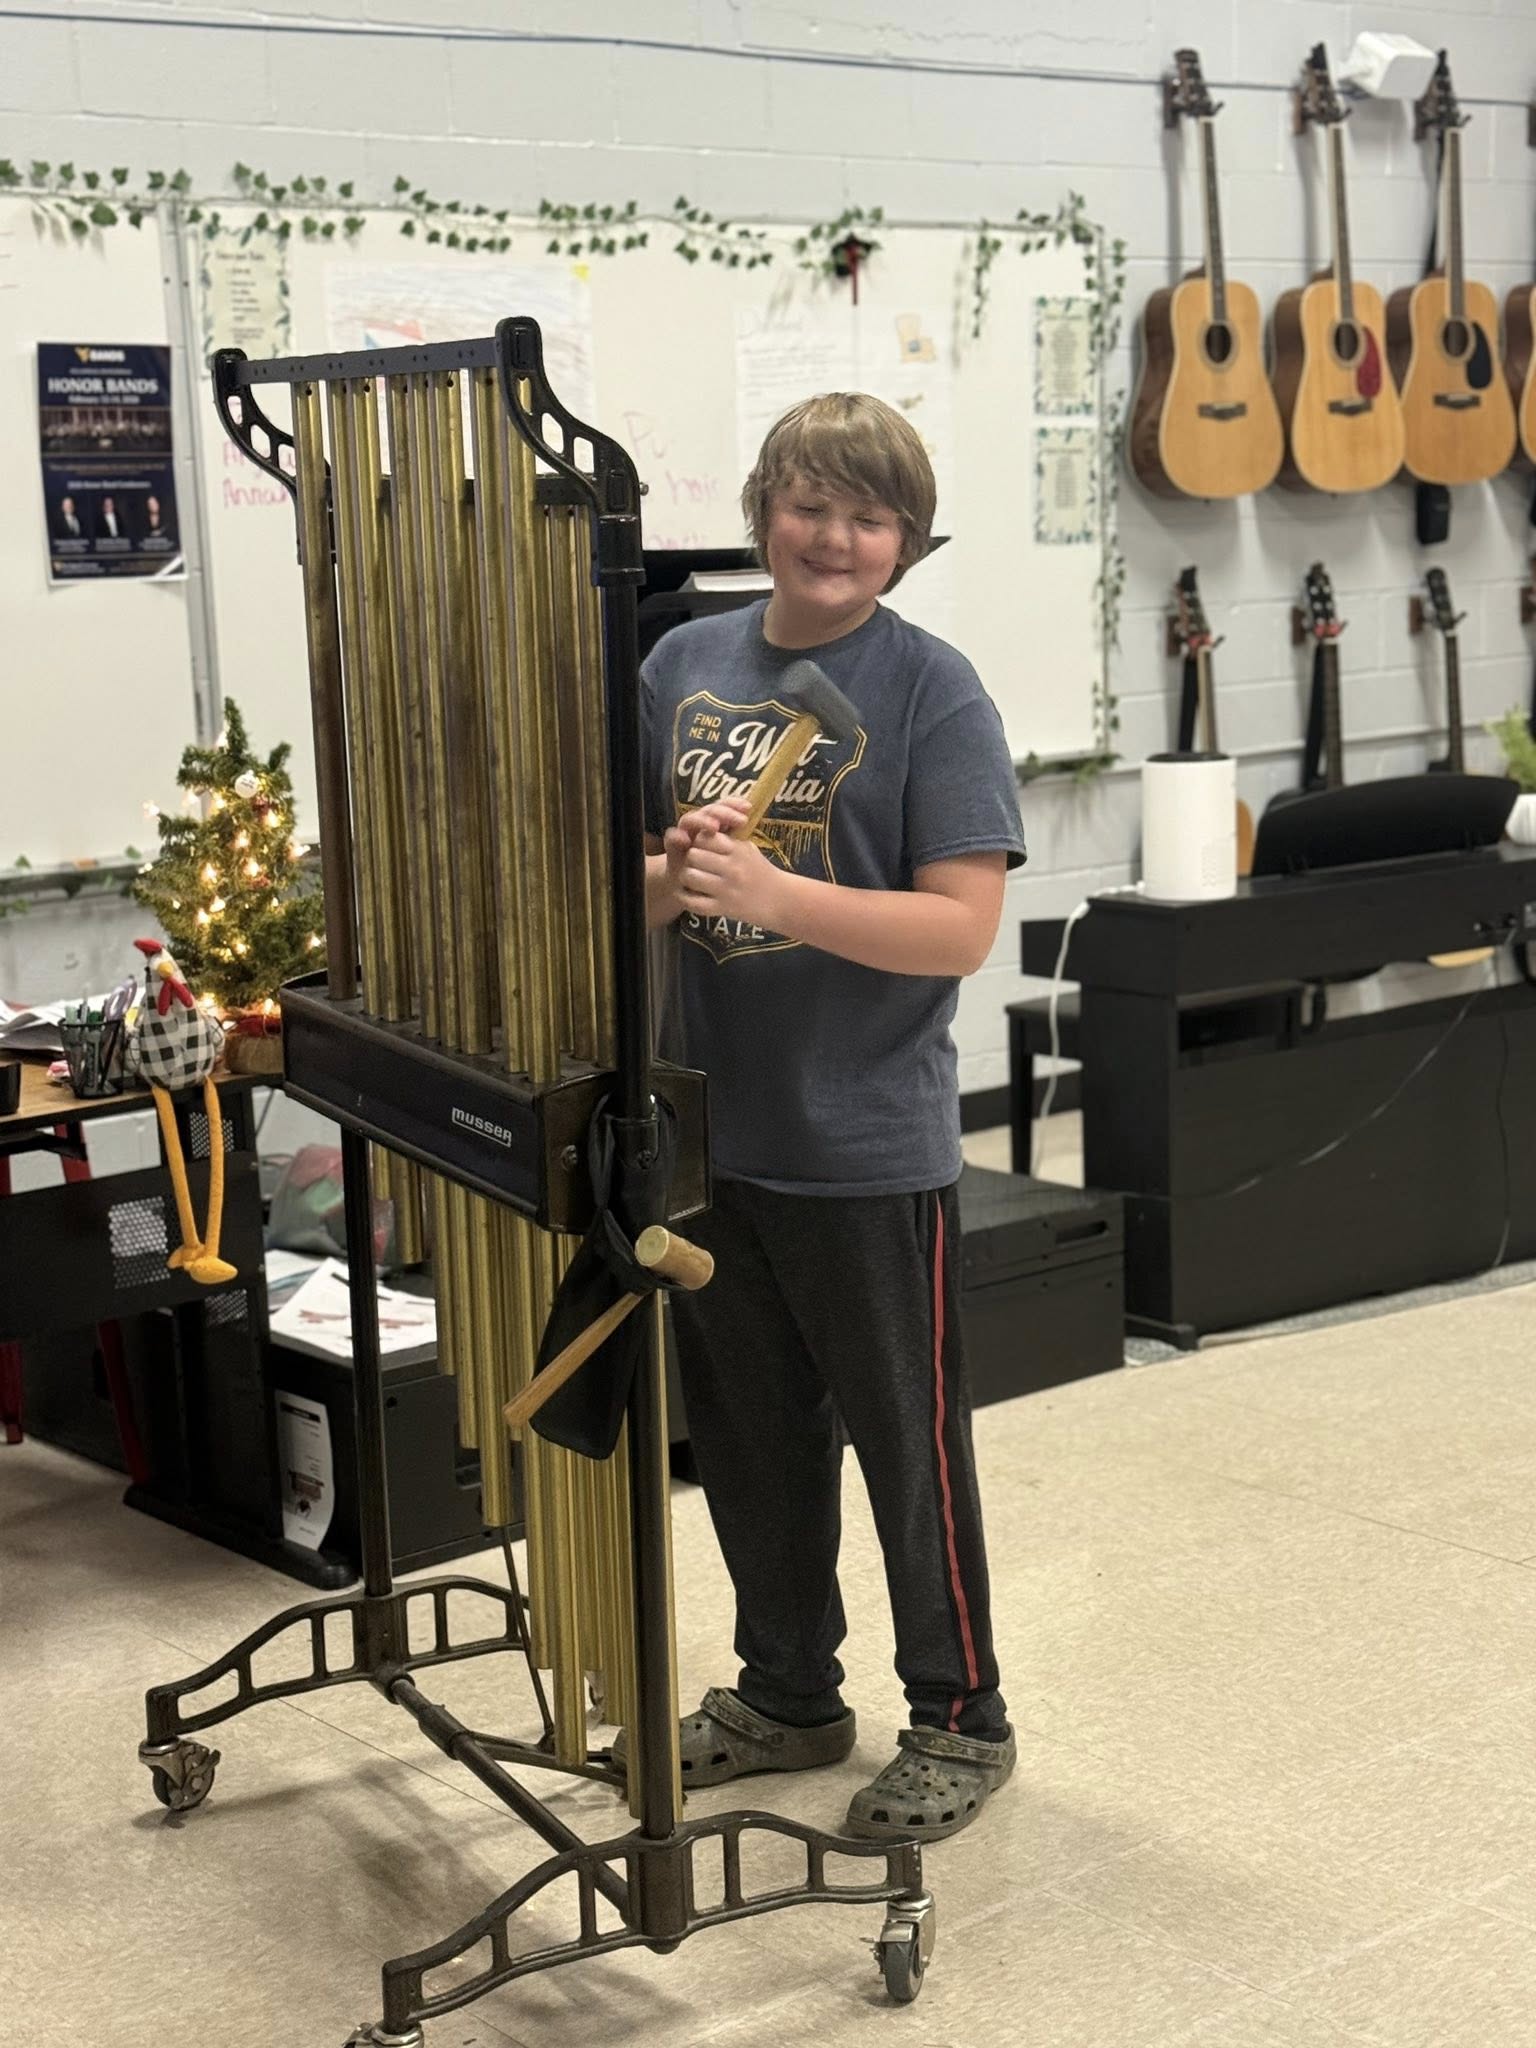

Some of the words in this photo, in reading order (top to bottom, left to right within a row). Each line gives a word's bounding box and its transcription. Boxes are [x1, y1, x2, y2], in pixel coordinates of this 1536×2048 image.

[48, 378, 103, 393] HONOR
[106, 378, 159, 394] BANDS
[694, 712, 721, 728] FIND
[688, 727, 704, 740] ME
[707, 731, 720, 743] IN
[727, 721, 838, 772] Wt
